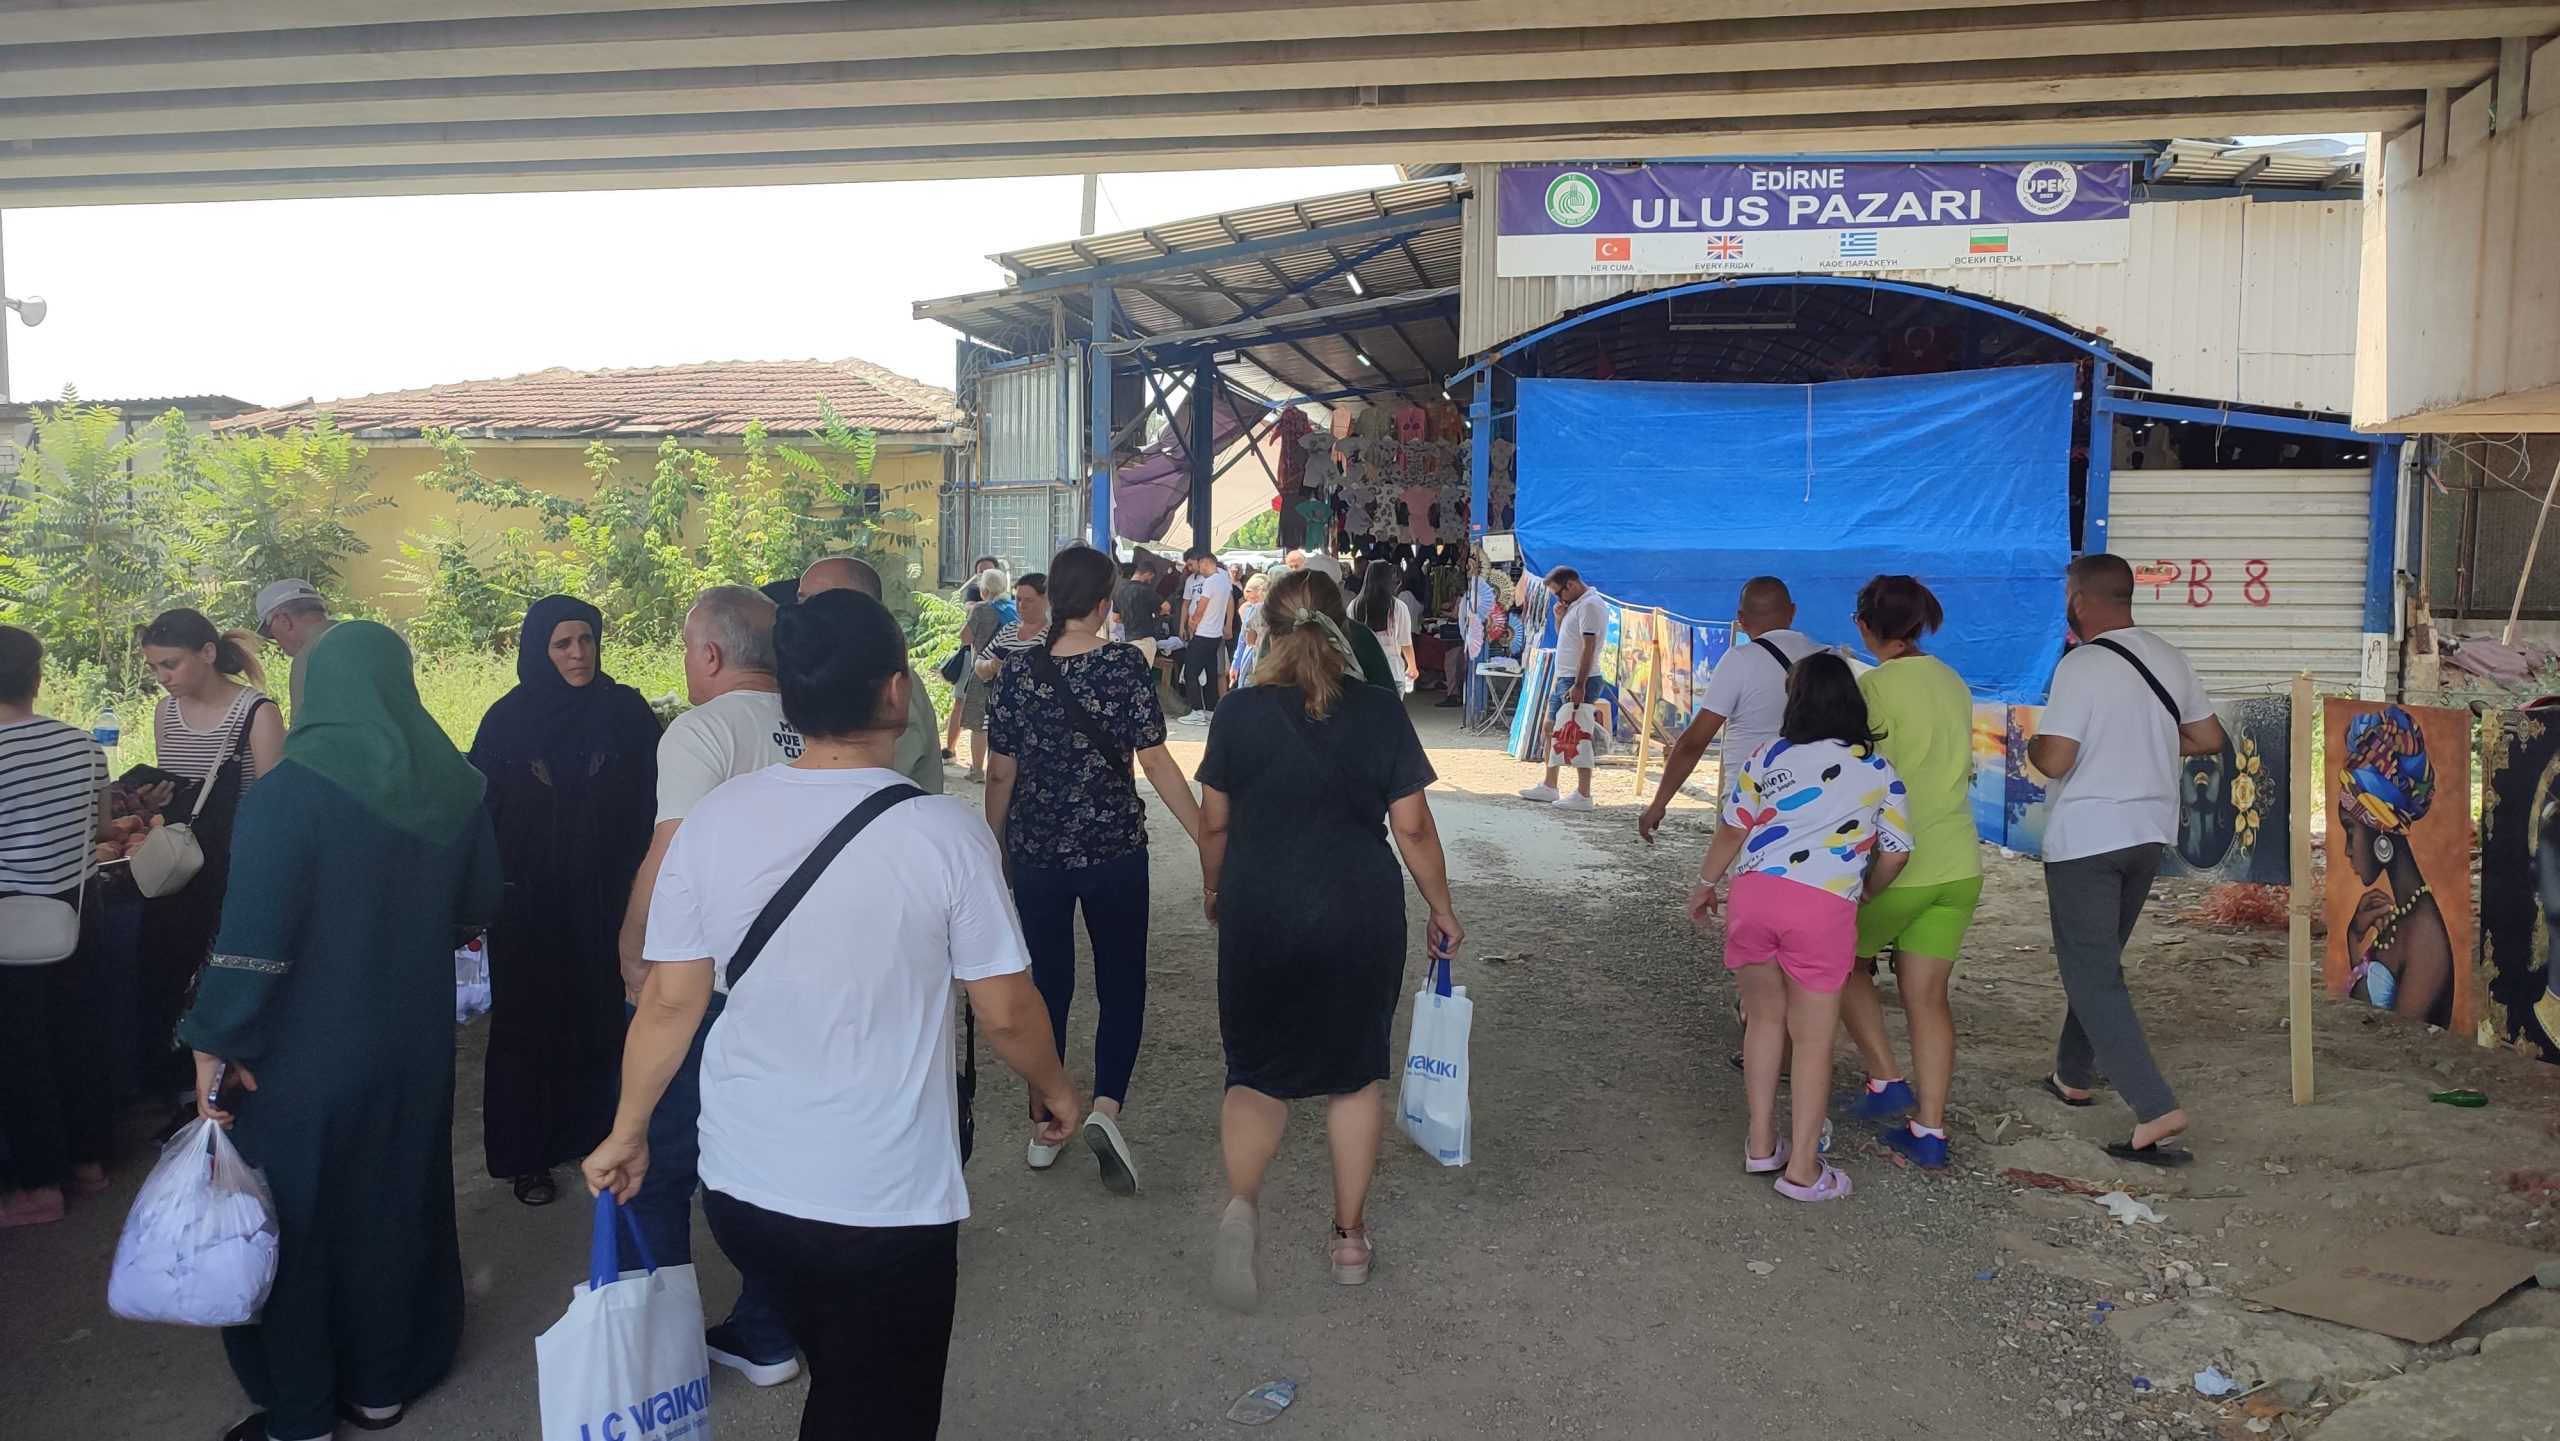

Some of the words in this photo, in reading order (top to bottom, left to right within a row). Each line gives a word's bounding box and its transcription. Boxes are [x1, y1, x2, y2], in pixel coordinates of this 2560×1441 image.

[1752, 165, 1844, 191] EDİRNE
[2023, 178, 2071, 194] UPEK
[1632, 195, 1769, 228] ULUS
[1789, 189, 1981, 225] PAZARI
[1610, 264, 1635, 272] CUMA
[1694, 262, 1723, 270] EVERY
[1724, 261, 1755, 269] FRIDAY
[1954, 256, 1987, 265] ВСЕКИ
[1989, 255, 2023, 264] ПЕТЪК
[2243, 559, 2271, 607] 8
